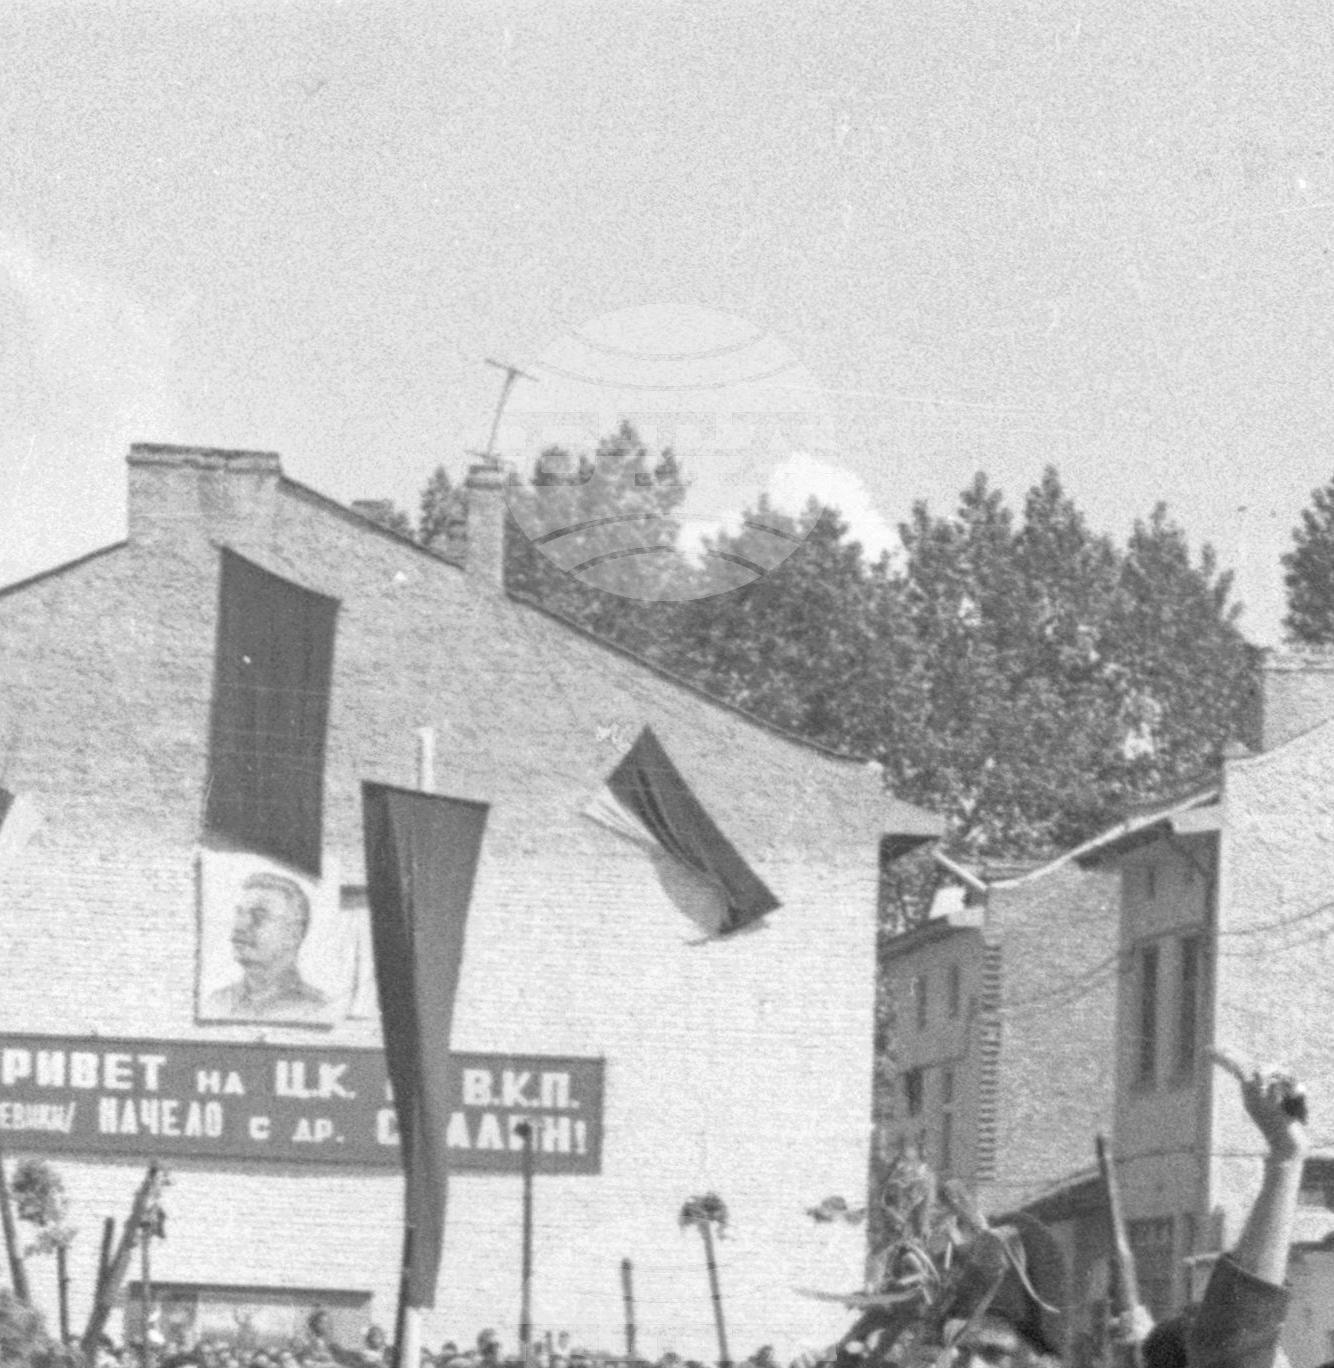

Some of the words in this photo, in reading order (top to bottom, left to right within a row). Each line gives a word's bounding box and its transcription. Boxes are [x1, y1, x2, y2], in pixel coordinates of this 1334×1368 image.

[274, 1060, 357, 1099] Ц.К.
[462, 1067, 581, 1109] В.К.П.
[98, 1096, 224, 1137] НАЧЕЛО
[376, 1107, 588, 1155] САЛИН!
